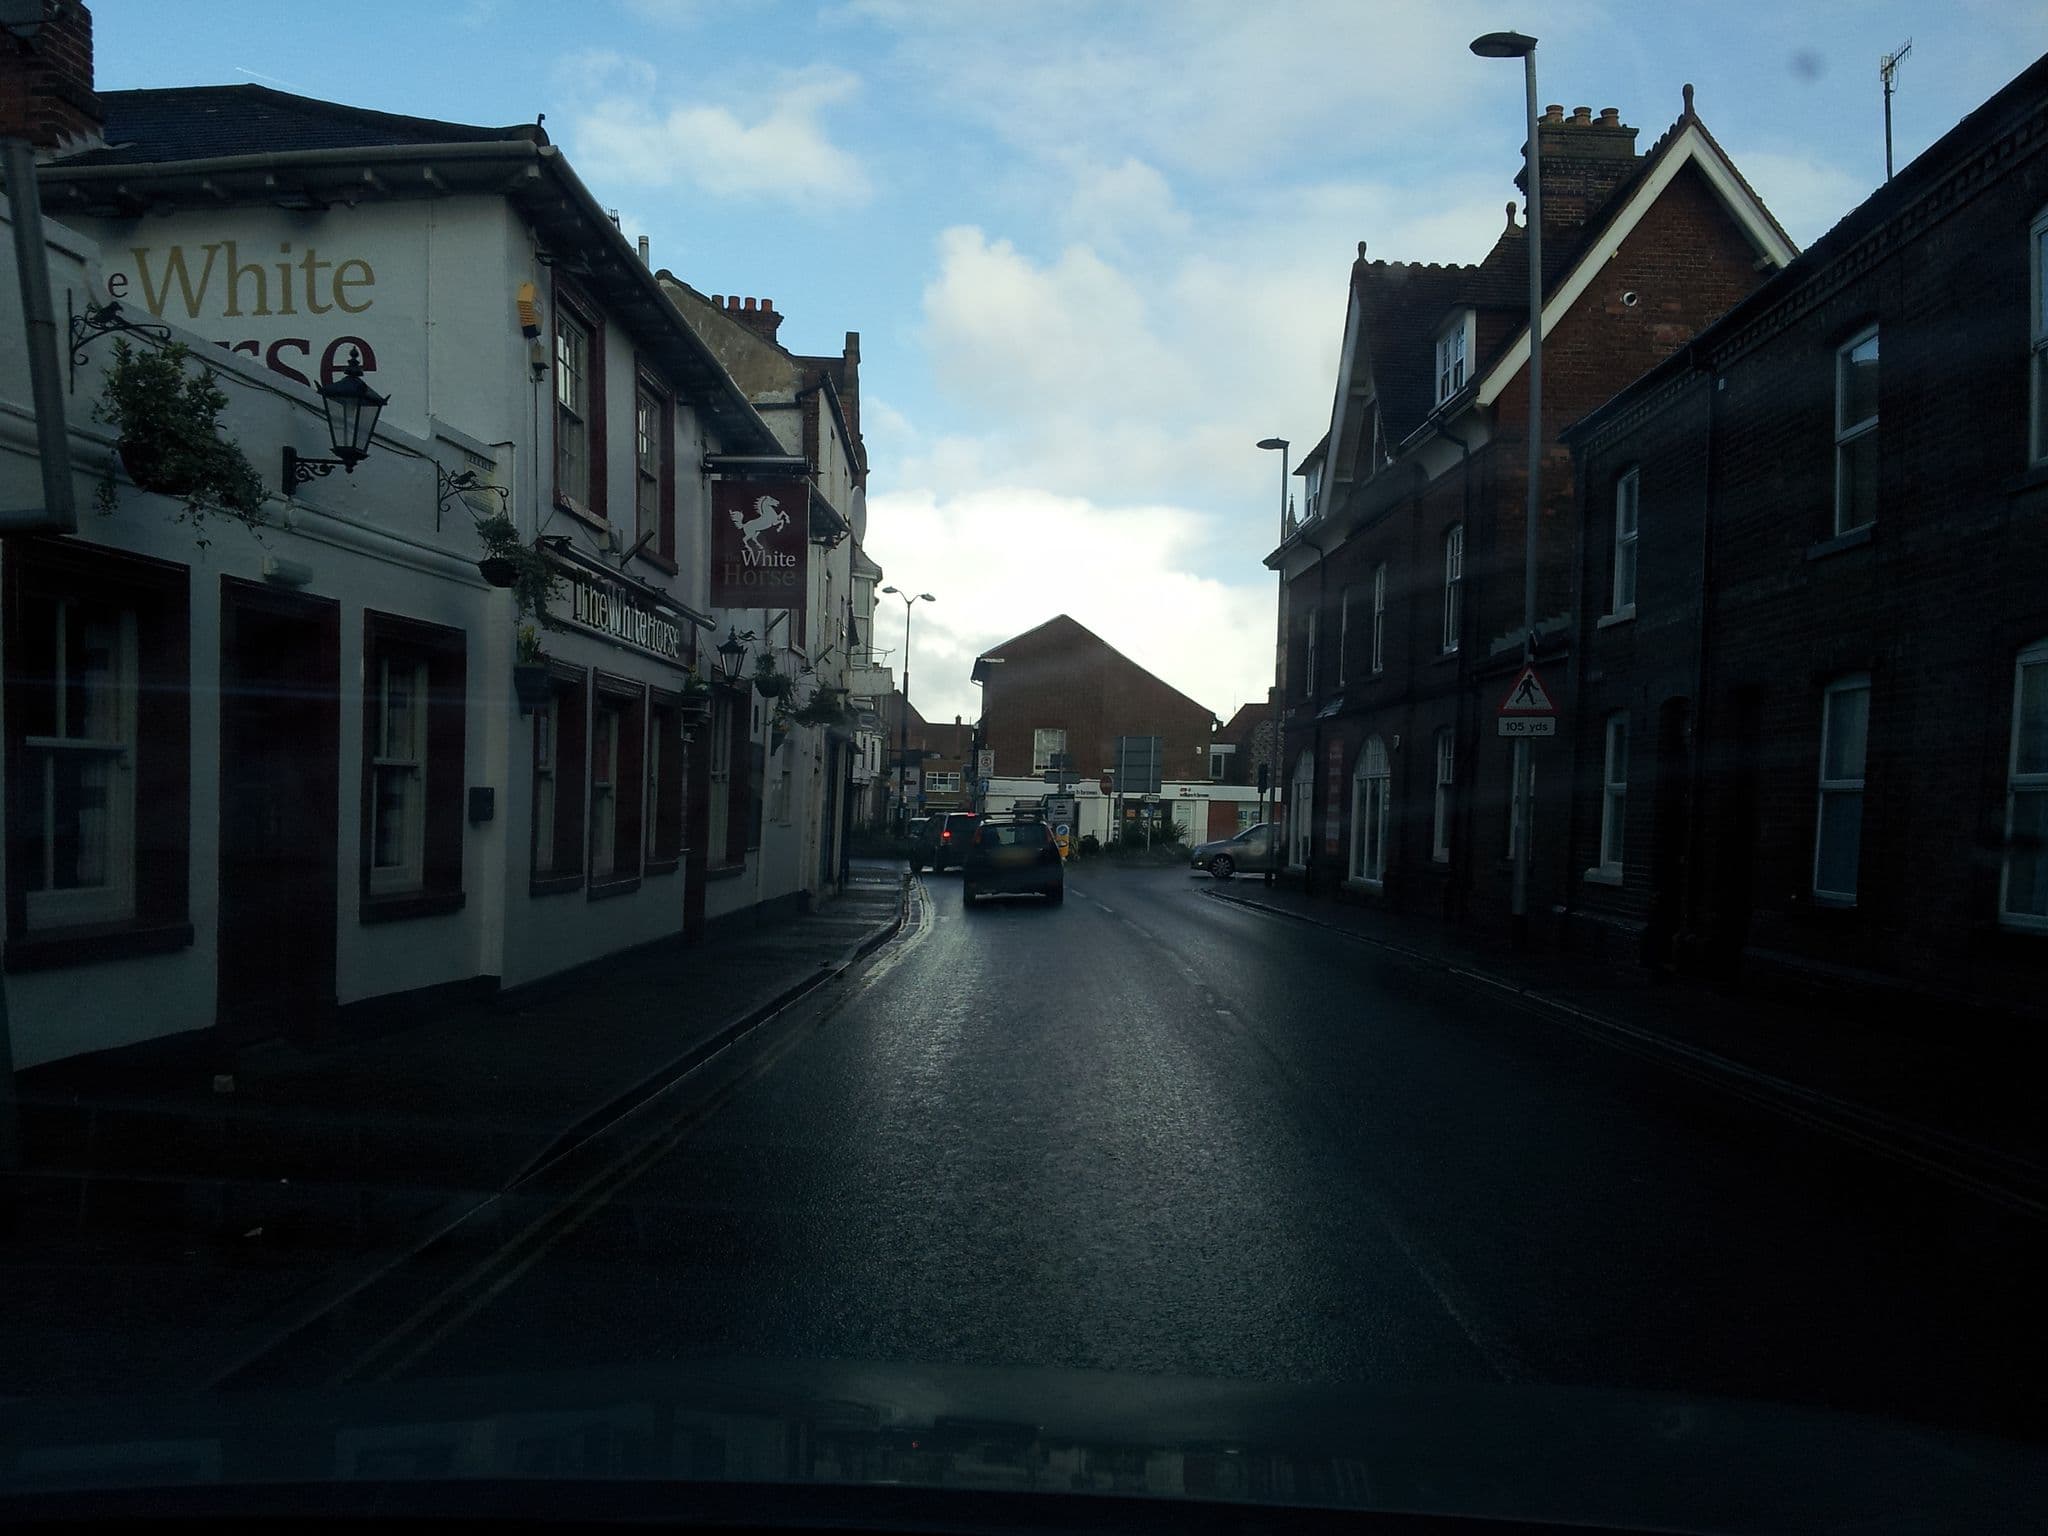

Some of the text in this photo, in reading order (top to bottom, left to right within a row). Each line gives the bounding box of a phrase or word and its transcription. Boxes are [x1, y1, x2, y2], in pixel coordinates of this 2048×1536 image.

[129, 240, 376, 318] White
[742, 549, 796, 567] White
[724, 563, 795, 586] Horse
[648, 611, 680, 658] Horse
[1506, 722, 1548, 731] 105 yds
